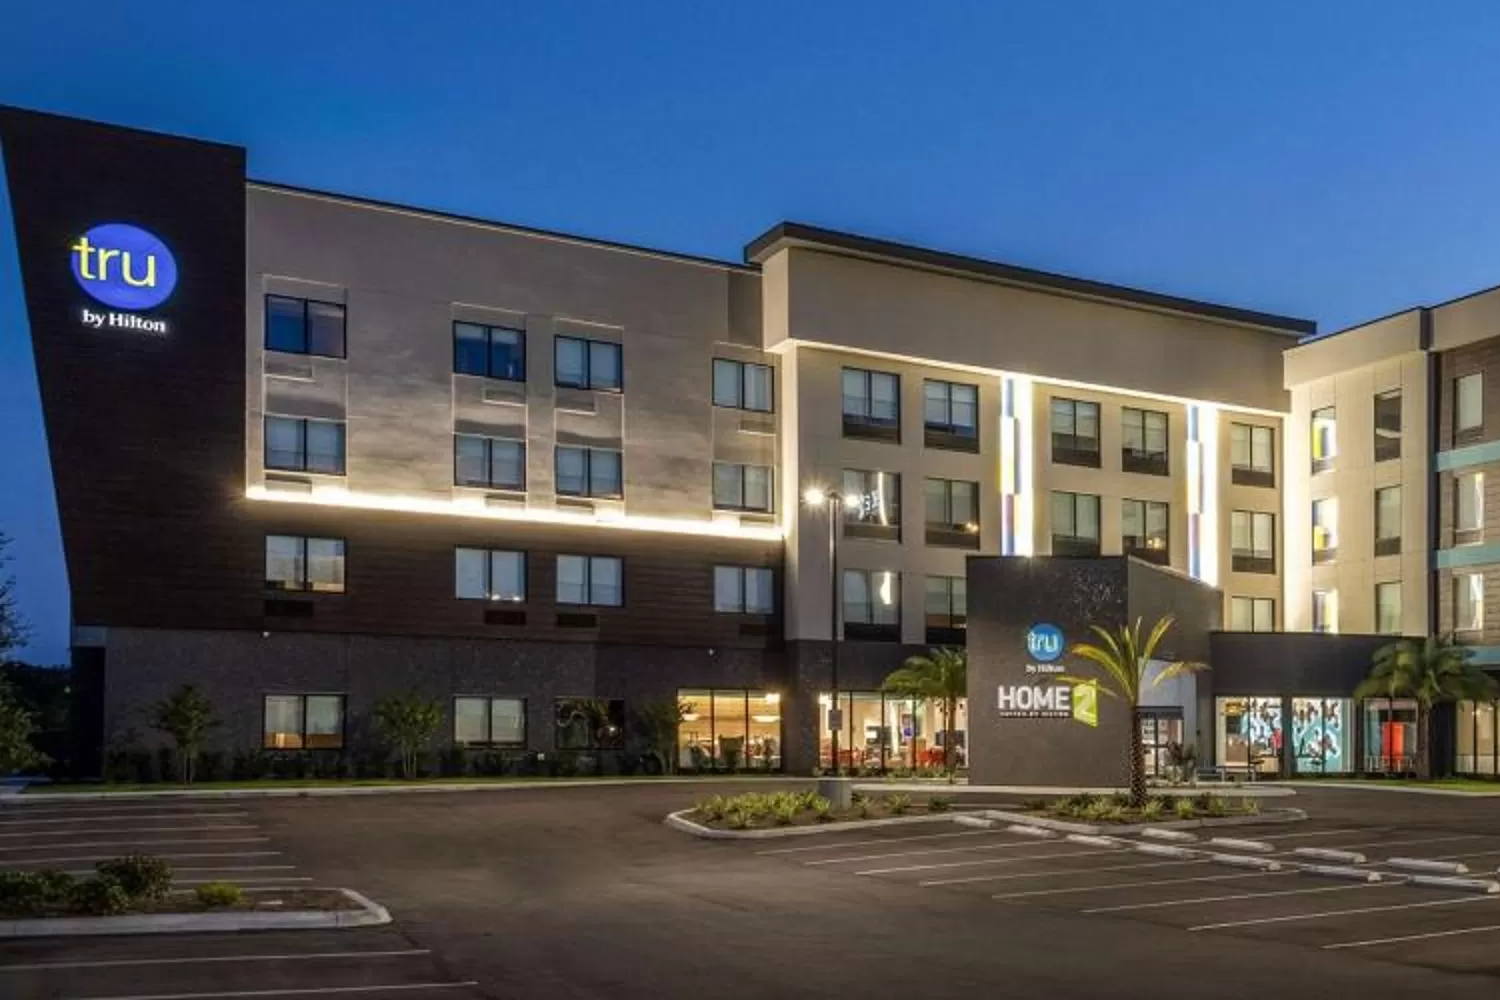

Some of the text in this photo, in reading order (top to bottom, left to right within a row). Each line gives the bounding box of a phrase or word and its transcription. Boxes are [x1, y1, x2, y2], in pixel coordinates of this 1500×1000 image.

[71, 237, 156, 287] tru
[82, 309, 166, 332] by Hilton
[1027, 631, 1059, 653] tru
[998, 685, 1071, 710] HOME
